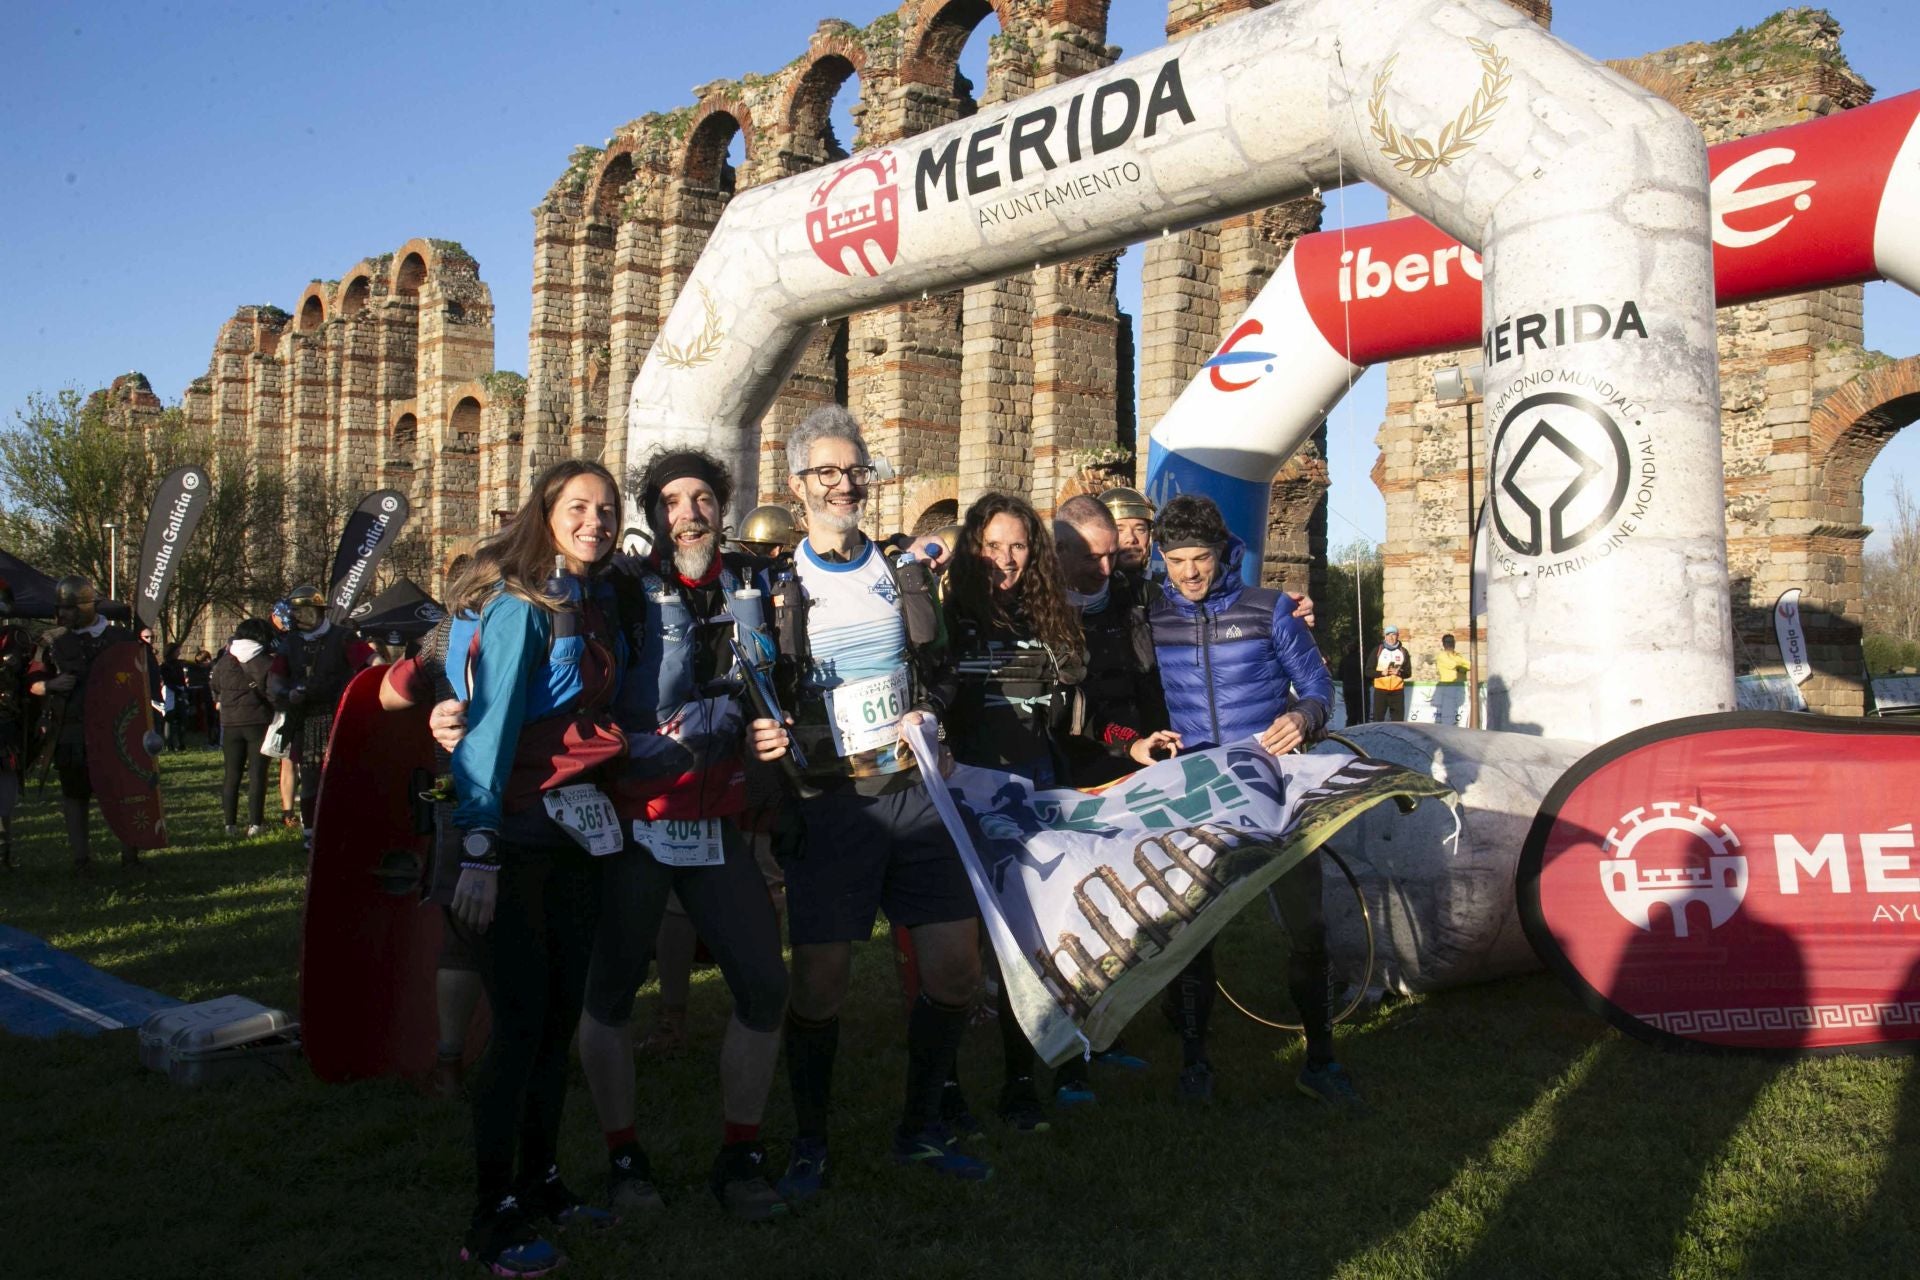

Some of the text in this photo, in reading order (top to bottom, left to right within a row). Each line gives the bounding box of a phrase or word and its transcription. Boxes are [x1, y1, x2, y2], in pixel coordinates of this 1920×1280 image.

[915, 58, 1196, 212] MÉRIDA
[979, 161, 1141, 228] AYUNTAMIENTO
[1484, 301, 1648, 367] MÉRIDA
[1558, 369, 1633, 416] MUNDIAL
[1537, 434, 1656, 579] PATRIMOINE MONDIAL
[144, 492, 192, 601] Estrella Galicia
[336, 514, 390, 610] Estrella Galicia
[862, 692, 899, 724] 616
[575, 803, 603, 832] 365
[1773, 823, 1920, 894] MÉ
